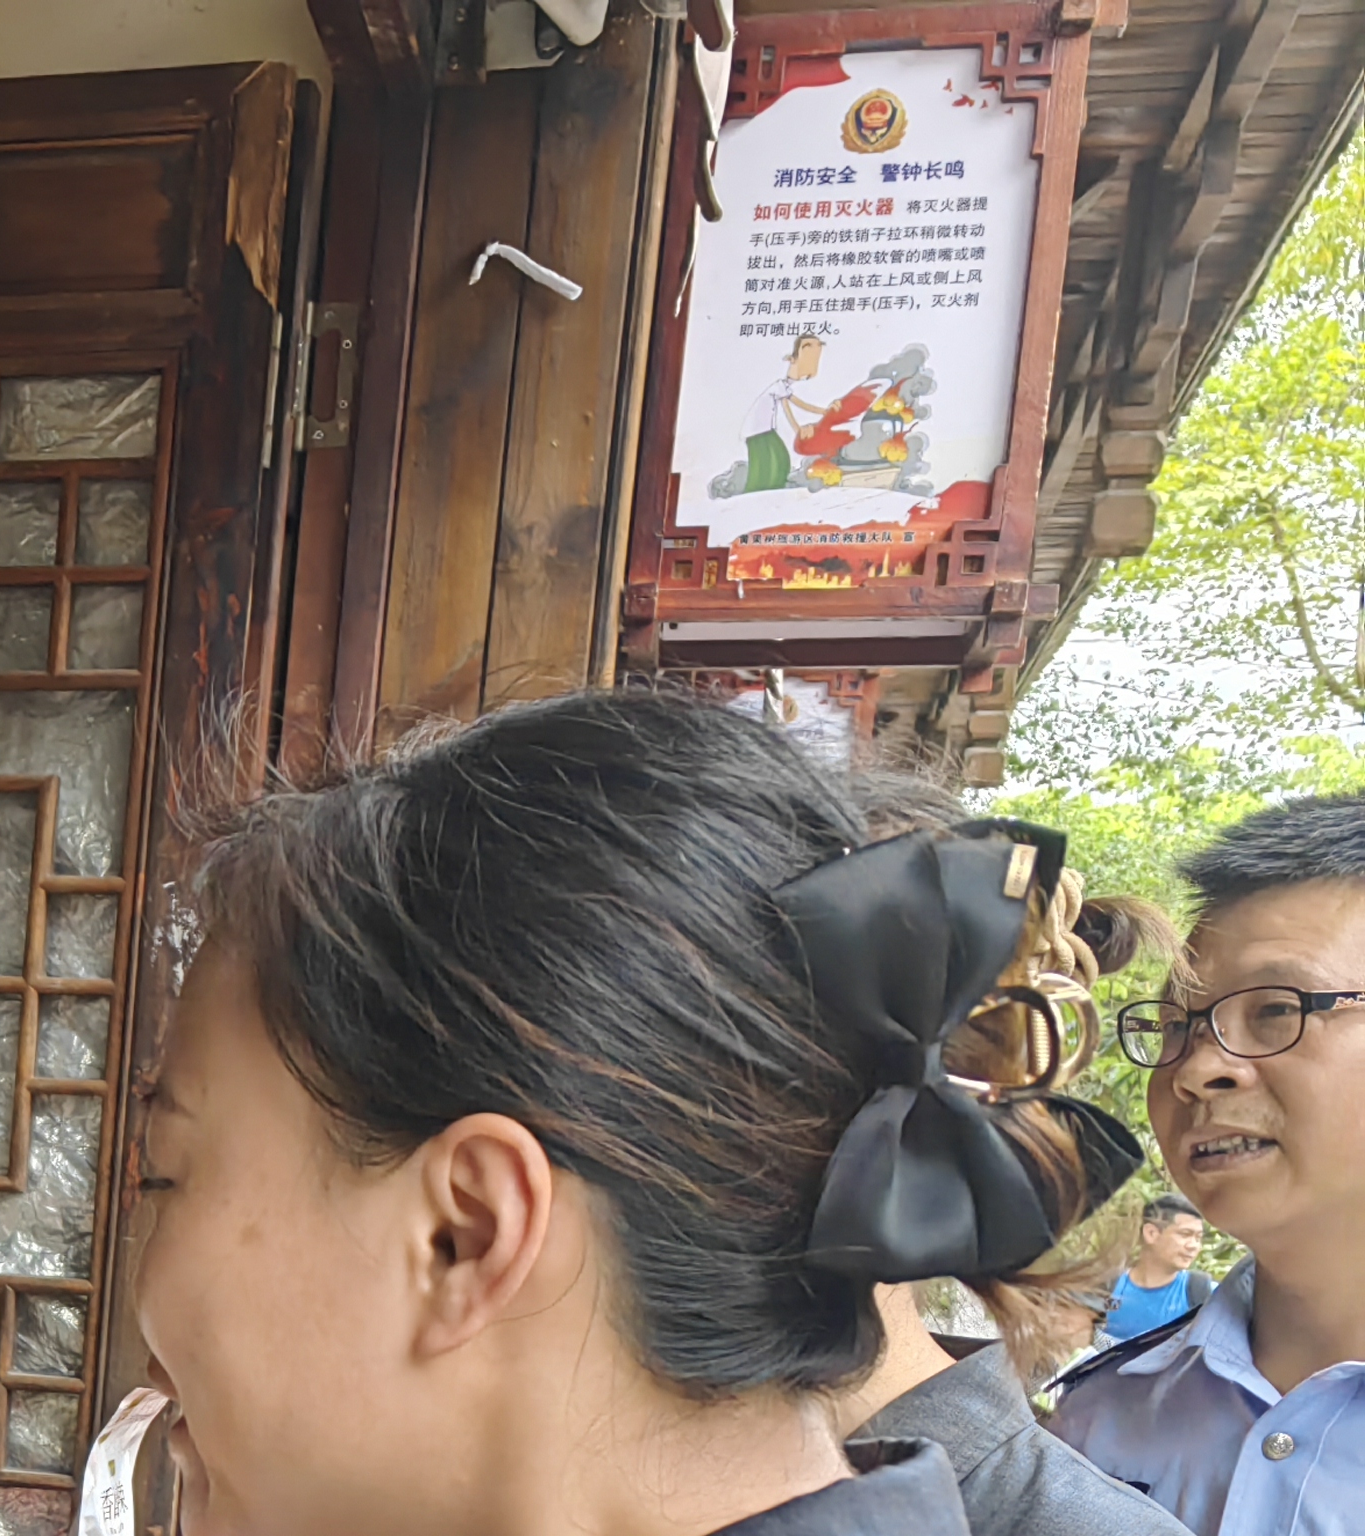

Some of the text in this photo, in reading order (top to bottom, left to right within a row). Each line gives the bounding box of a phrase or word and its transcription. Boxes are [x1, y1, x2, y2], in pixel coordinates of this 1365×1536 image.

[773, 160, 965, 188] 消防安全 警钟长鸣
[753, 196, 988, 221] 如何使用灭火器 将灭火器提
[749, 223, 986, 248] 手(压手)旁的铁销子拉环稍微转动
